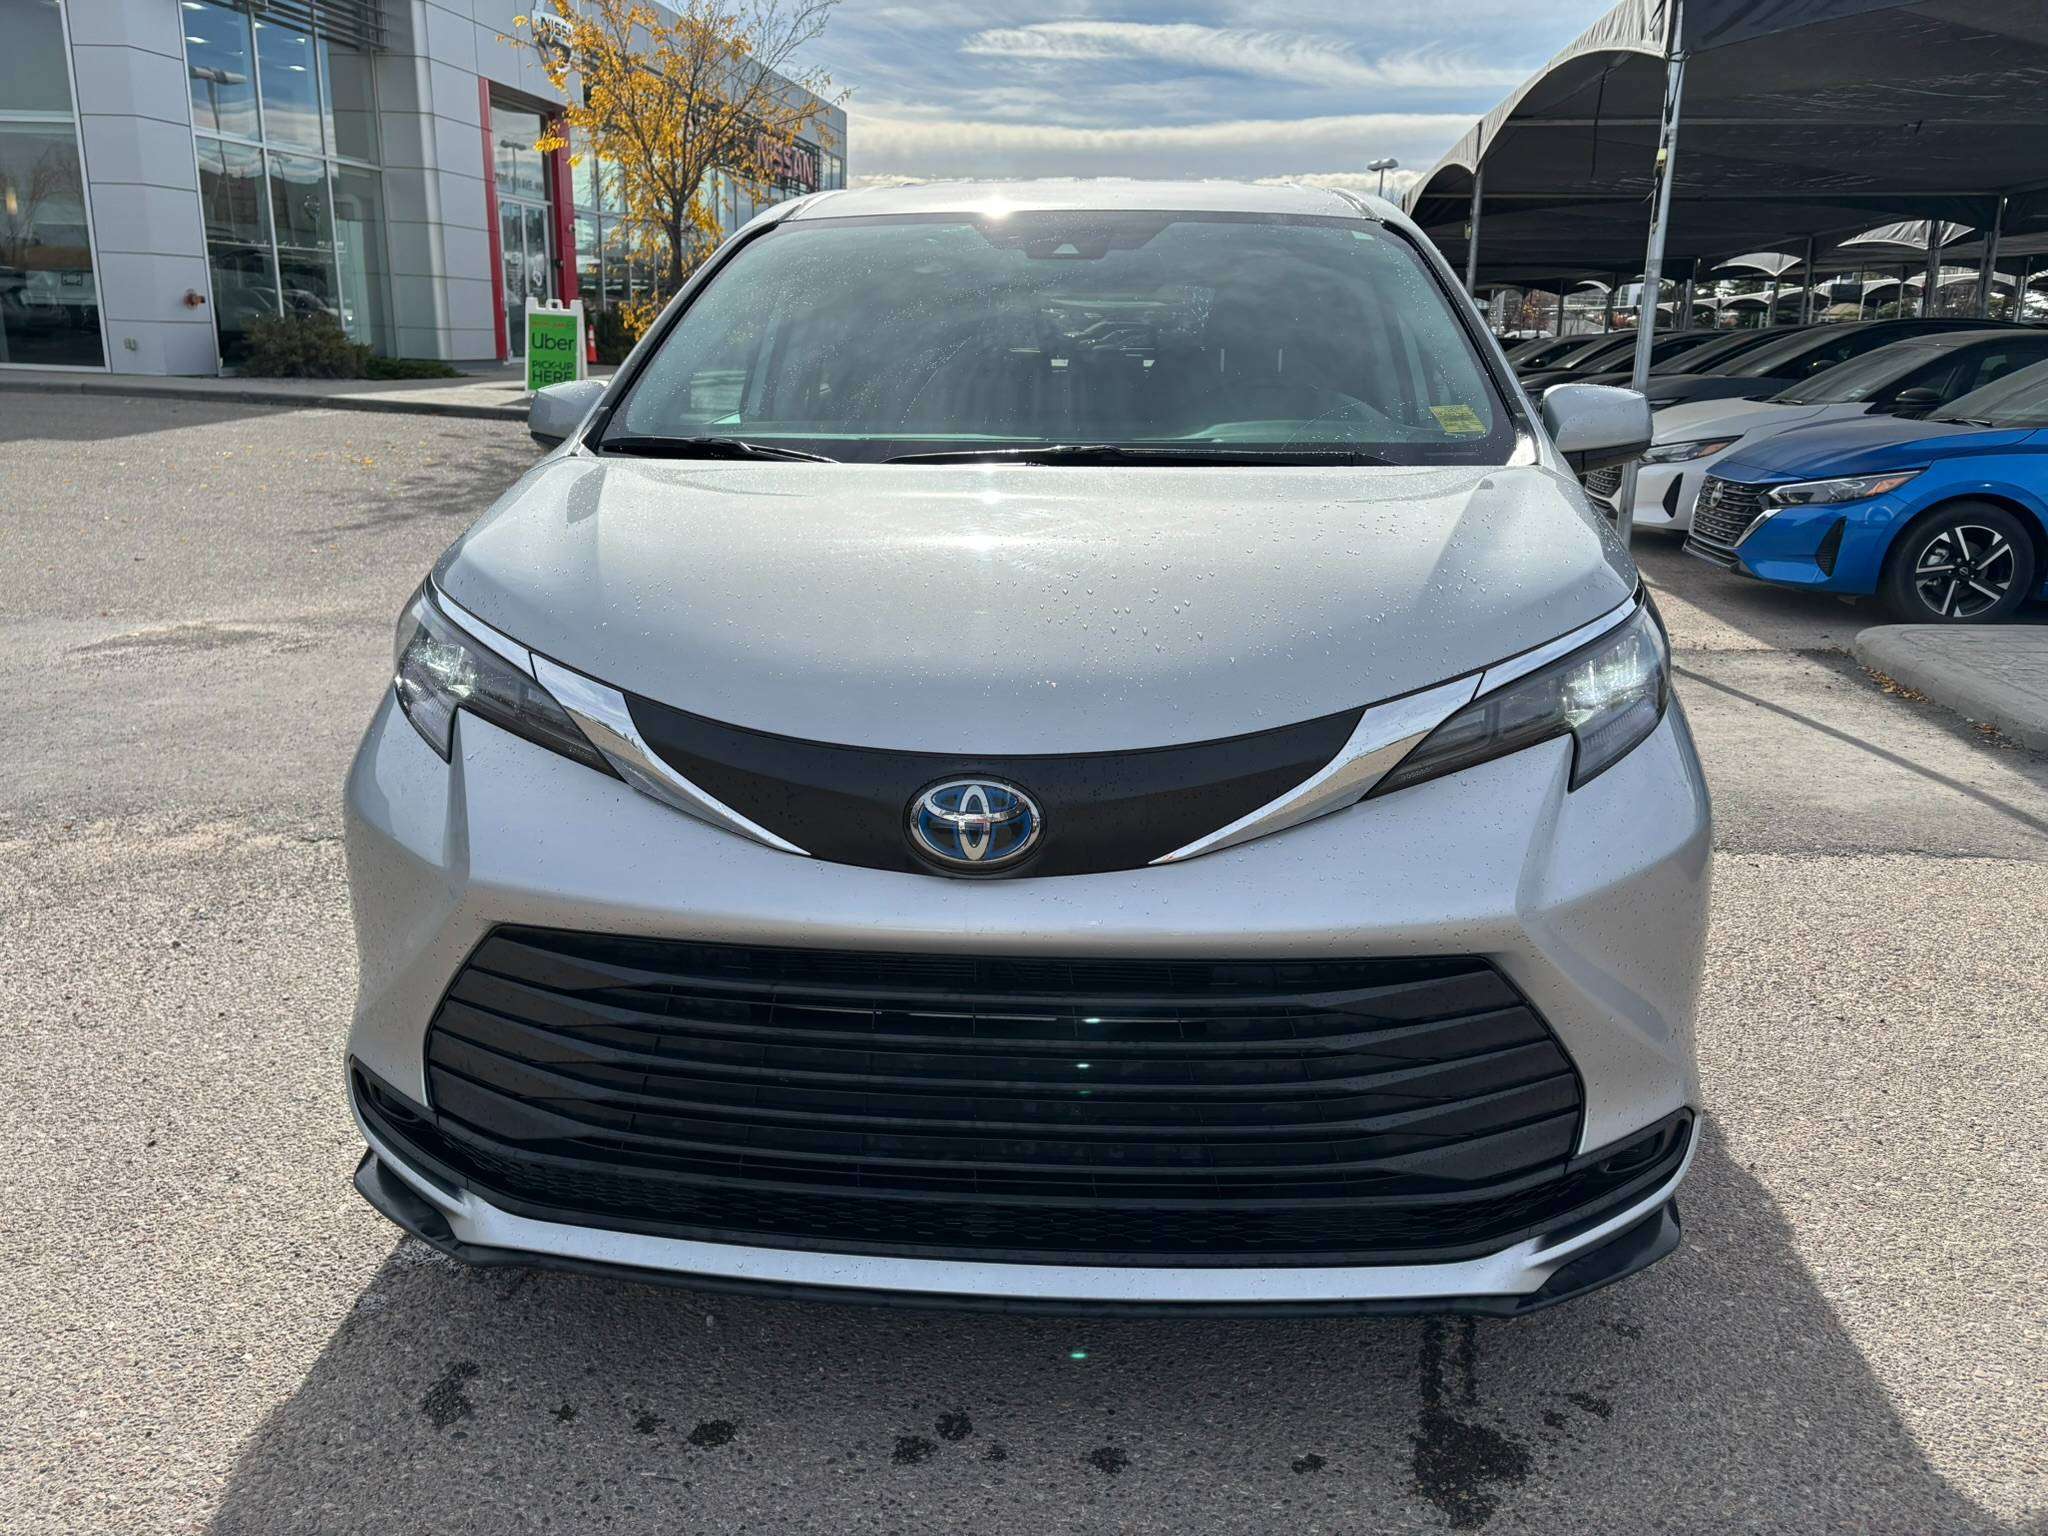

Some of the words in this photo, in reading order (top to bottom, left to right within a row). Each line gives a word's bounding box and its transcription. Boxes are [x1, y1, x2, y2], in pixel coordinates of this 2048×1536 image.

[541, 16, 571, 38] NISS
[531, 332, 575, 351] Uber
[532, 369, 573, 384] HERE
